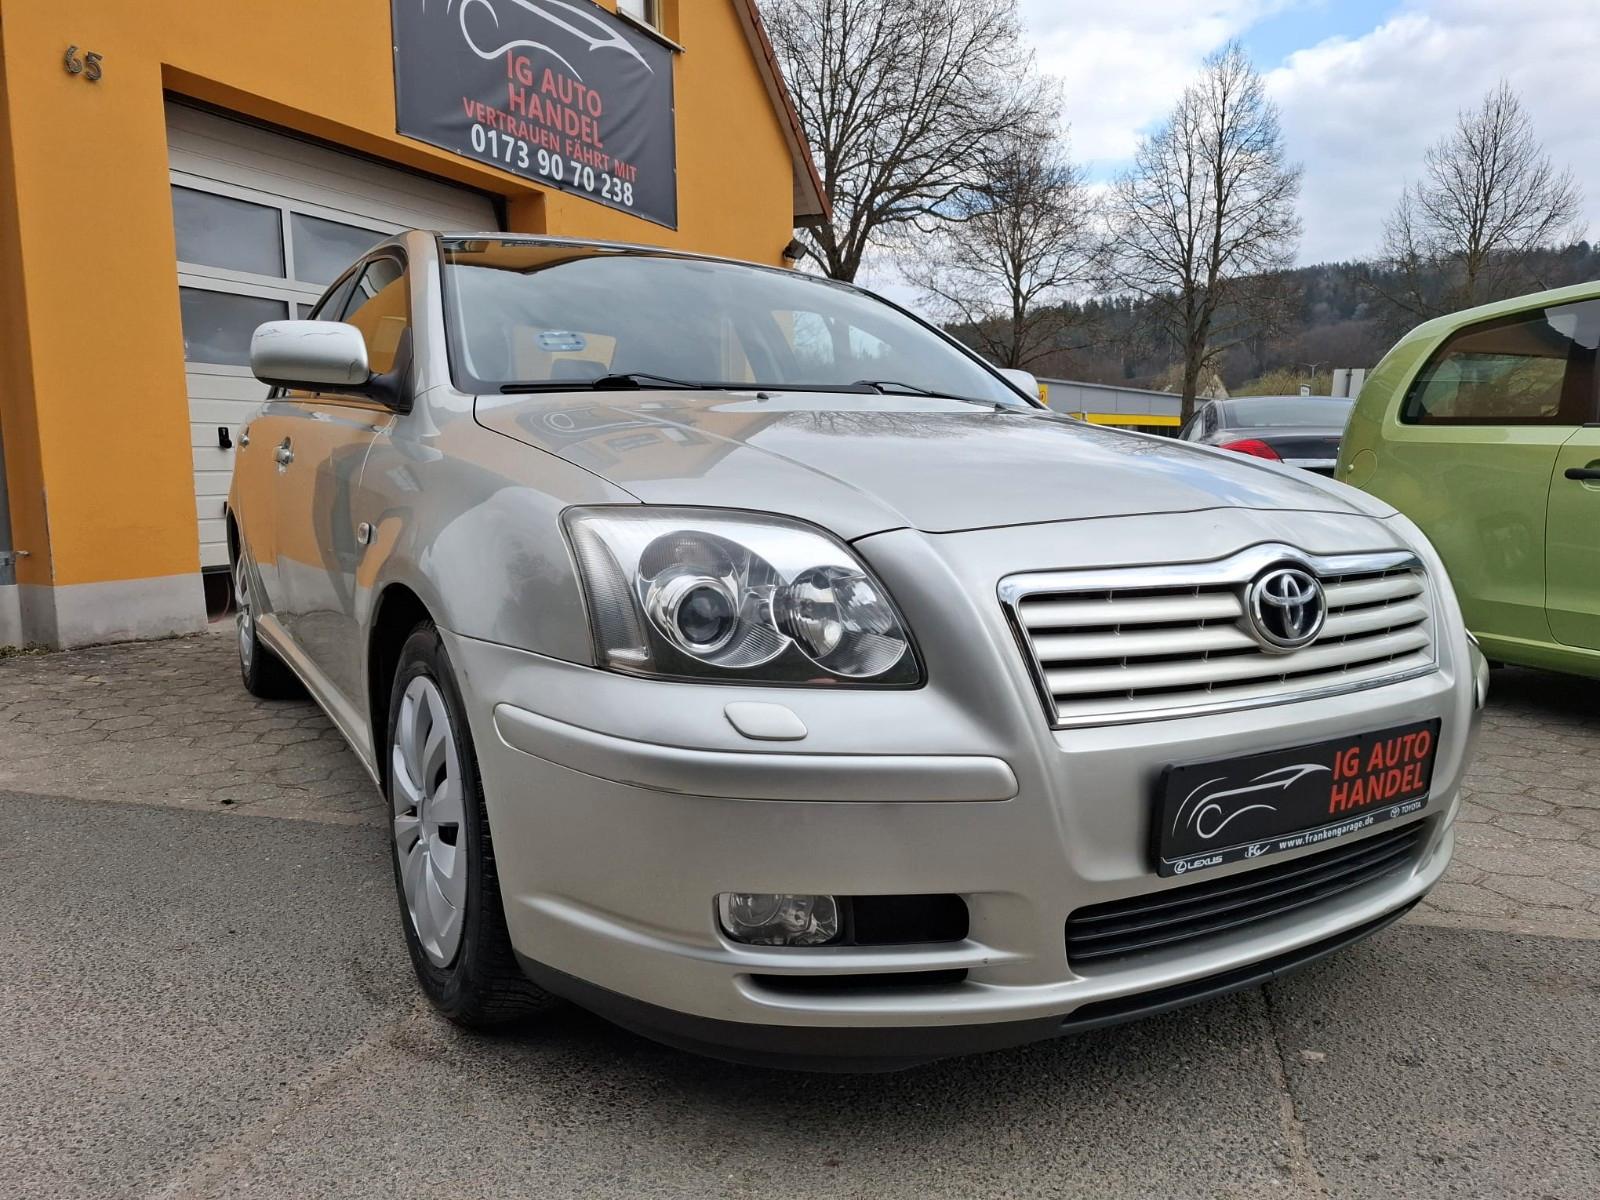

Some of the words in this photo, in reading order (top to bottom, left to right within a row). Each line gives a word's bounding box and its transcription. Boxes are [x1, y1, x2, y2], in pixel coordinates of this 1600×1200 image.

[64, 46, 103, 80] 65
[507, 50, 533, 87] IG
[541, 68, 602, 118] AUTO
[463, 97, 560, 153] VERTRAUEN
[566, 139, 610, 171] FÄHRT
[615, 159, 637, 182] MIT
[508, 83, 603, 149] HANDEL
[471, 123, 529, 168] 0173
[537, 149, 563, 181] 90
[571, 161, 594, 192] 70
[601, 173, 633, 206] 238
[1333, 747, 1360, 780] IG
[1366, 730, 1431, 772] AUTO
[1328, 762, 1423, 814] HANDEL
[1401, 801, 1422, 814] TOYOTA
[1279, 816, 1374, 849] www.frankengarage.de
[1187, 855, 1223, 869] LEXUS
